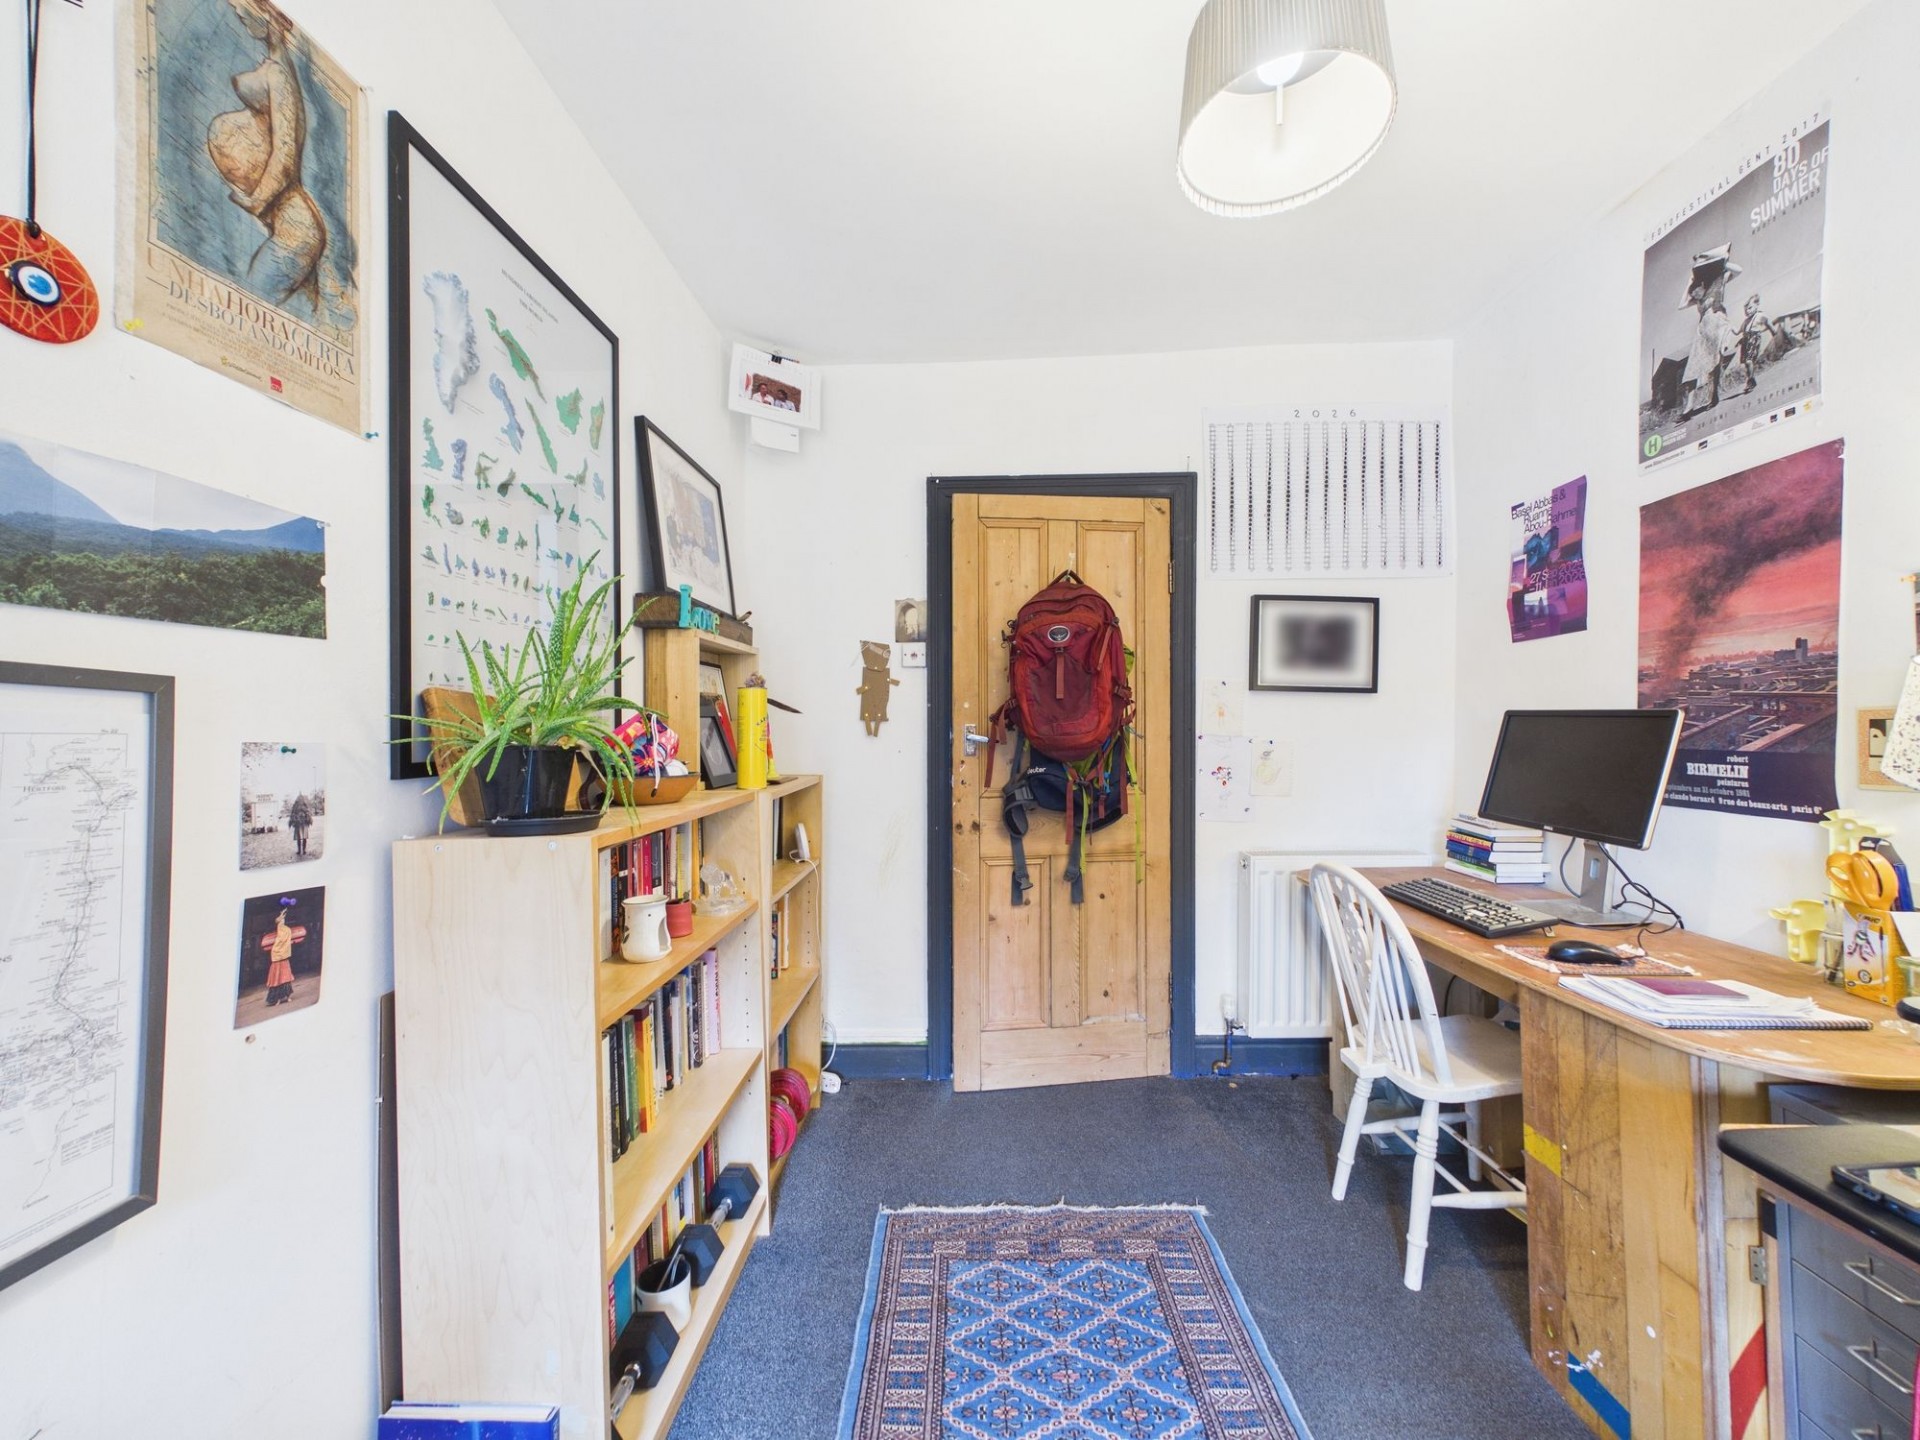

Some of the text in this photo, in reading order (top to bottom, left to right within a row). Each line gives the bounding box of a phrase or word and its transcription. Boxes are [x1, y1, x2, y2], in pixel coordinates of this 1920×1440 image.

[1773, 140, 1801, 178] 80
[1651, 112, 1819, 241] FOTOFESTIVAL GENT 2017
[1773, 145, 1830, 194] DAYS OF
[1750, 168, 1822, 230] SUMMER
[1293, 409, 1357, 419] 2026
[1512, 503, 1532, 520] Basel
[1533, 494, 1559, 510] Abbas
[1529, 572, 1541, 584] 27
[1726, 754, 1749, 763] robert
[1686, 762, 1749, 779] BIRMELIN
[1709, 787, 1735, 796] octobre
[1716, 778, 1749, 788] peintures
[1669, 792, 1689, 801] claude
[1689, 794, 1715, 803] bernard
[1723, 798, 1735, 806] rue
[1736, 798, 1748, 807] des
[1749, 799, 1788, 811] beaux-arts
[1791, 805, 1813, 815] paris
